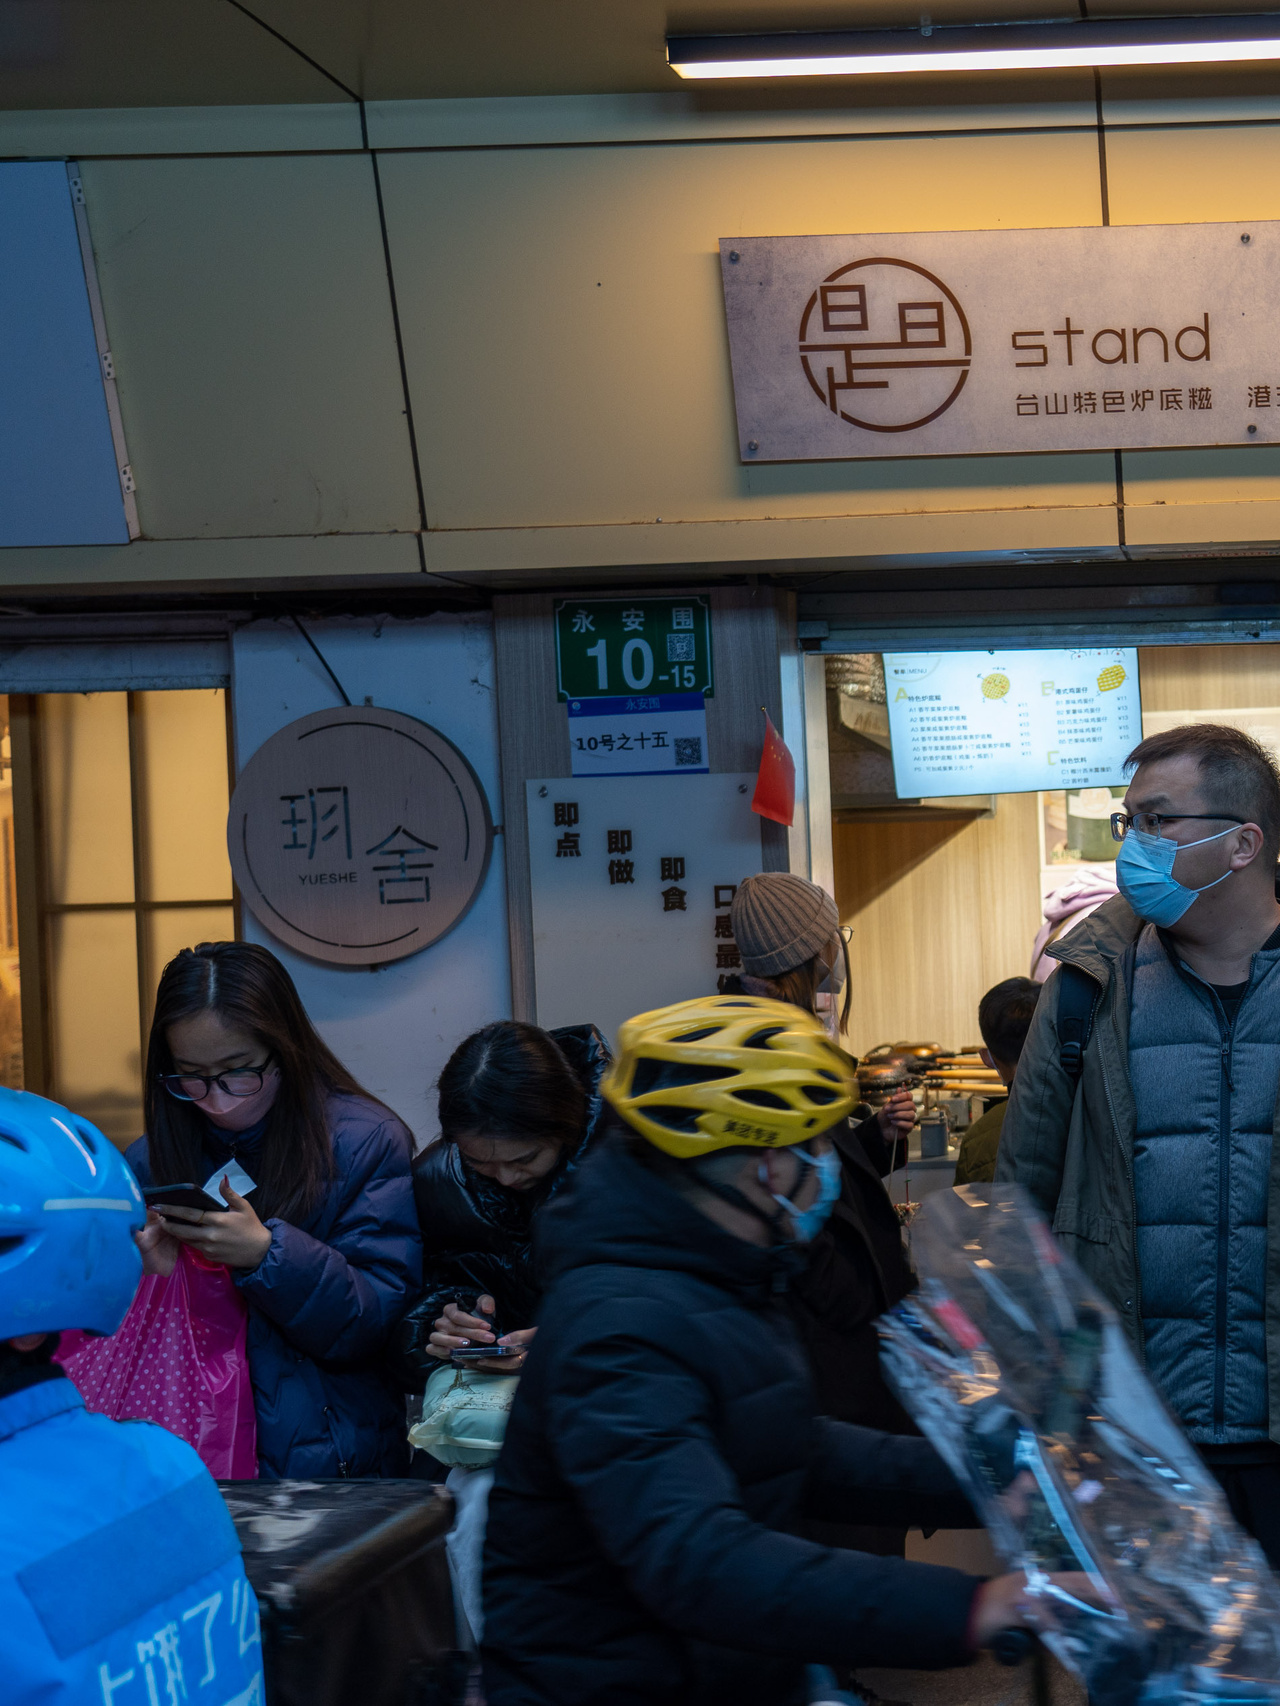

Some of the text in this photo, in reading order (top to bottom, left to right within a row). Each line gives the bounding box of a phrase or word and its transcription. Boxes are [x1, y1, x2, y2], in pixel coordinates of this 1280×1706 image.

[1012, 312, 1211, 367] stand
[1015, 387, 1213, 416] 台山特色炉底糍
[572, 607, 694, 633] 永安围
[625, 698, 661, 711] 永安围
[895, 687, 909, 702] A
[576, 731, 670, 752] 10号之十五
[553, 802, 582, 858] 即点
[607, 829, 635, 885] 即做
[299, 871, 358, 885] YUESHE
[660, 856, 688, 913] 即食
